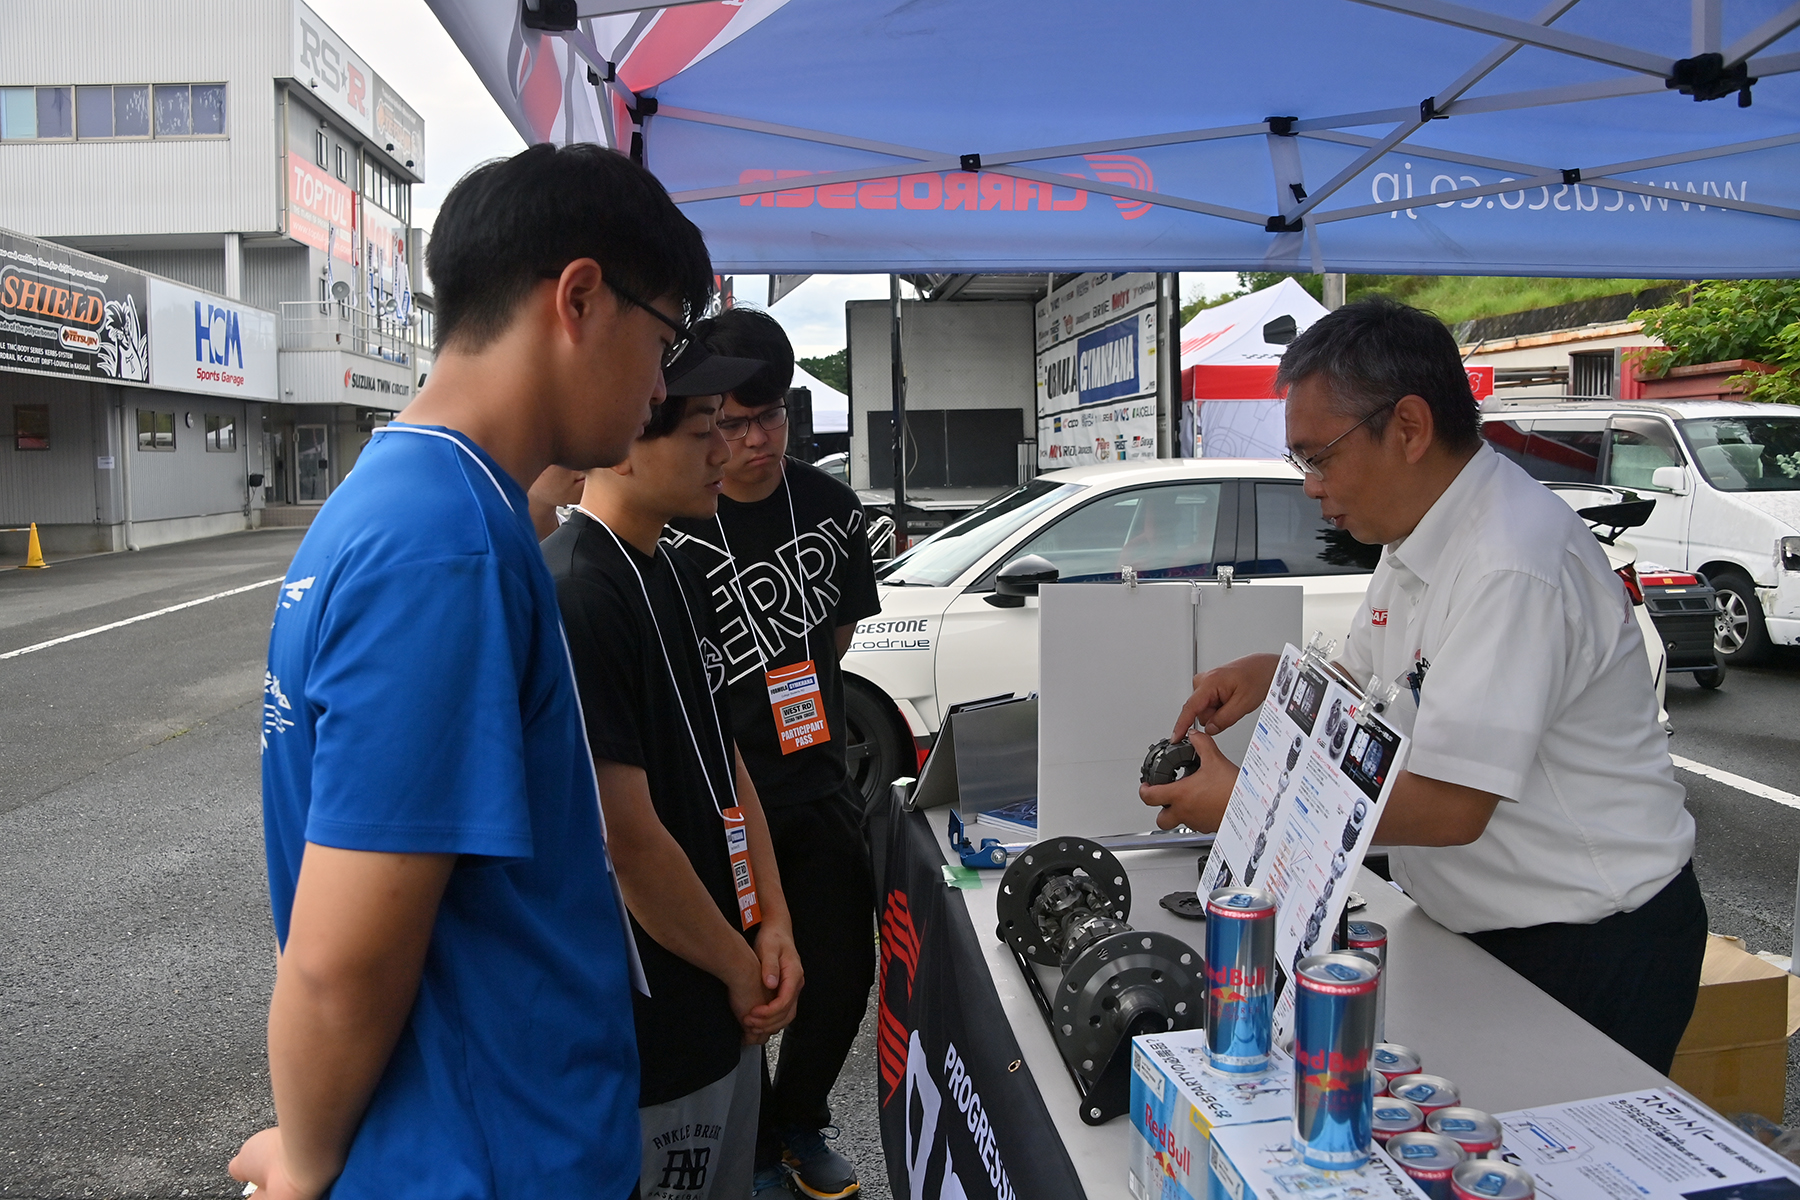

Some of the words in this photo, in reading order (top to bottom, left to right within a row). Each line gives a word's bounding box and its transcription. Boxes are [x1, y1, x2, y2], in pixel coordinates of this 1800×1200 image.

[294, 166, 348, 226] TOPTUL
[1, 275, 103, 325] SHIELD
[195, 301, 243, 369] HCM
[197, 368, 220, 382] Sports
[221, 371, 244, 386] Garage
[352, 373, 376, 391] SUZUKA
[377, 378, 391, 394] TWIN
[391, 383, 409, 396] CIRCUIT
[770, 684, 788, 695] FORMULA
[783, 705, 801, 716] WEST
[802, 702, 812, 711] RD
[781, 720, 824, 741] PARTICIPANT
[795, 734, 814, 747] PASS
[1229, 968, 1265, 987] Bull
[1636, 1094, 1714, 1141] ストラットバー
[652, 1124, 690, 1150] ANKLE
[1146, 1103, 1166, 1149] Red
[1168, 1129, 1190, 1177] Bull
